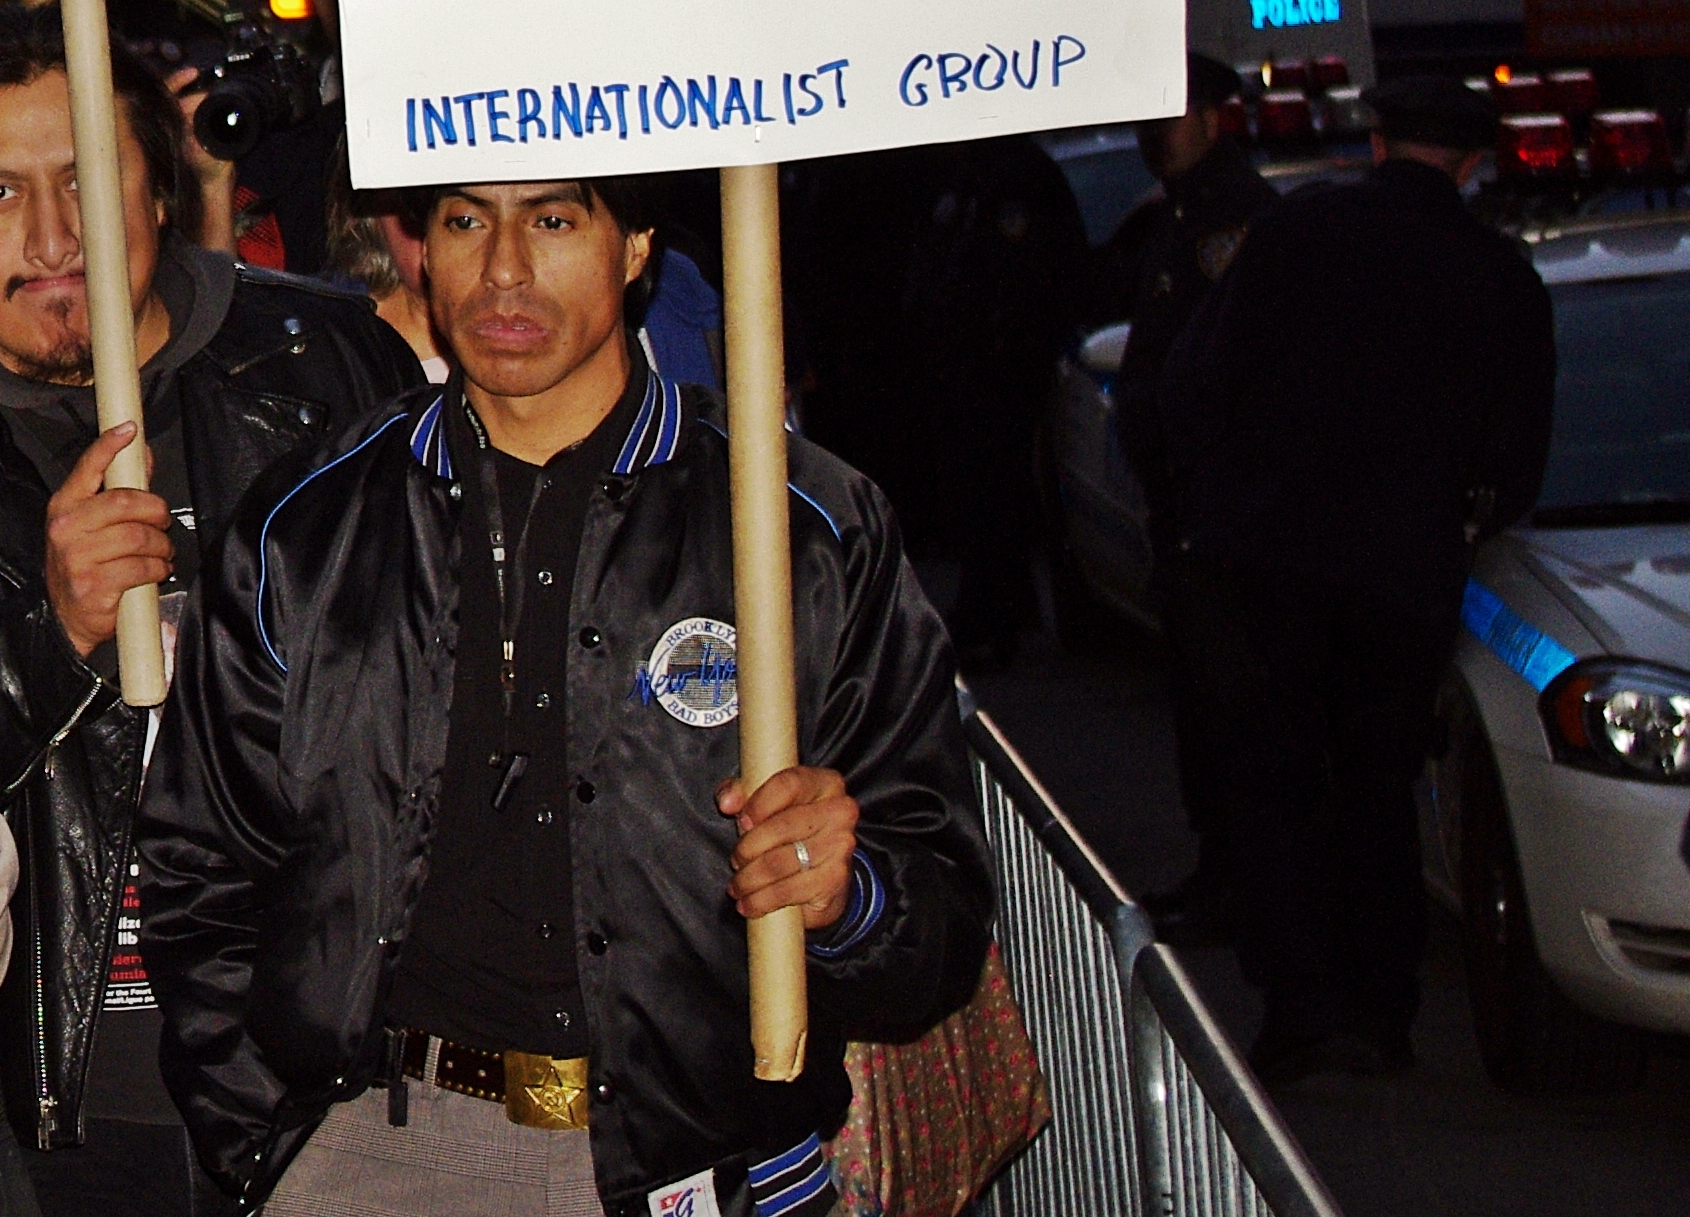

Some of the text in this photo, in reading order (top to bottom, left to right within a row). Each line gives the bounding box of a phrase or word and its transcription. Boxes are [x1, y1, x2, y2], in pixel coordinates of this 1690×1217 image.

[405, 35, 1087, 154] INTERNATIONALIST GROUP
[666, 699, 698, 724] BAD
